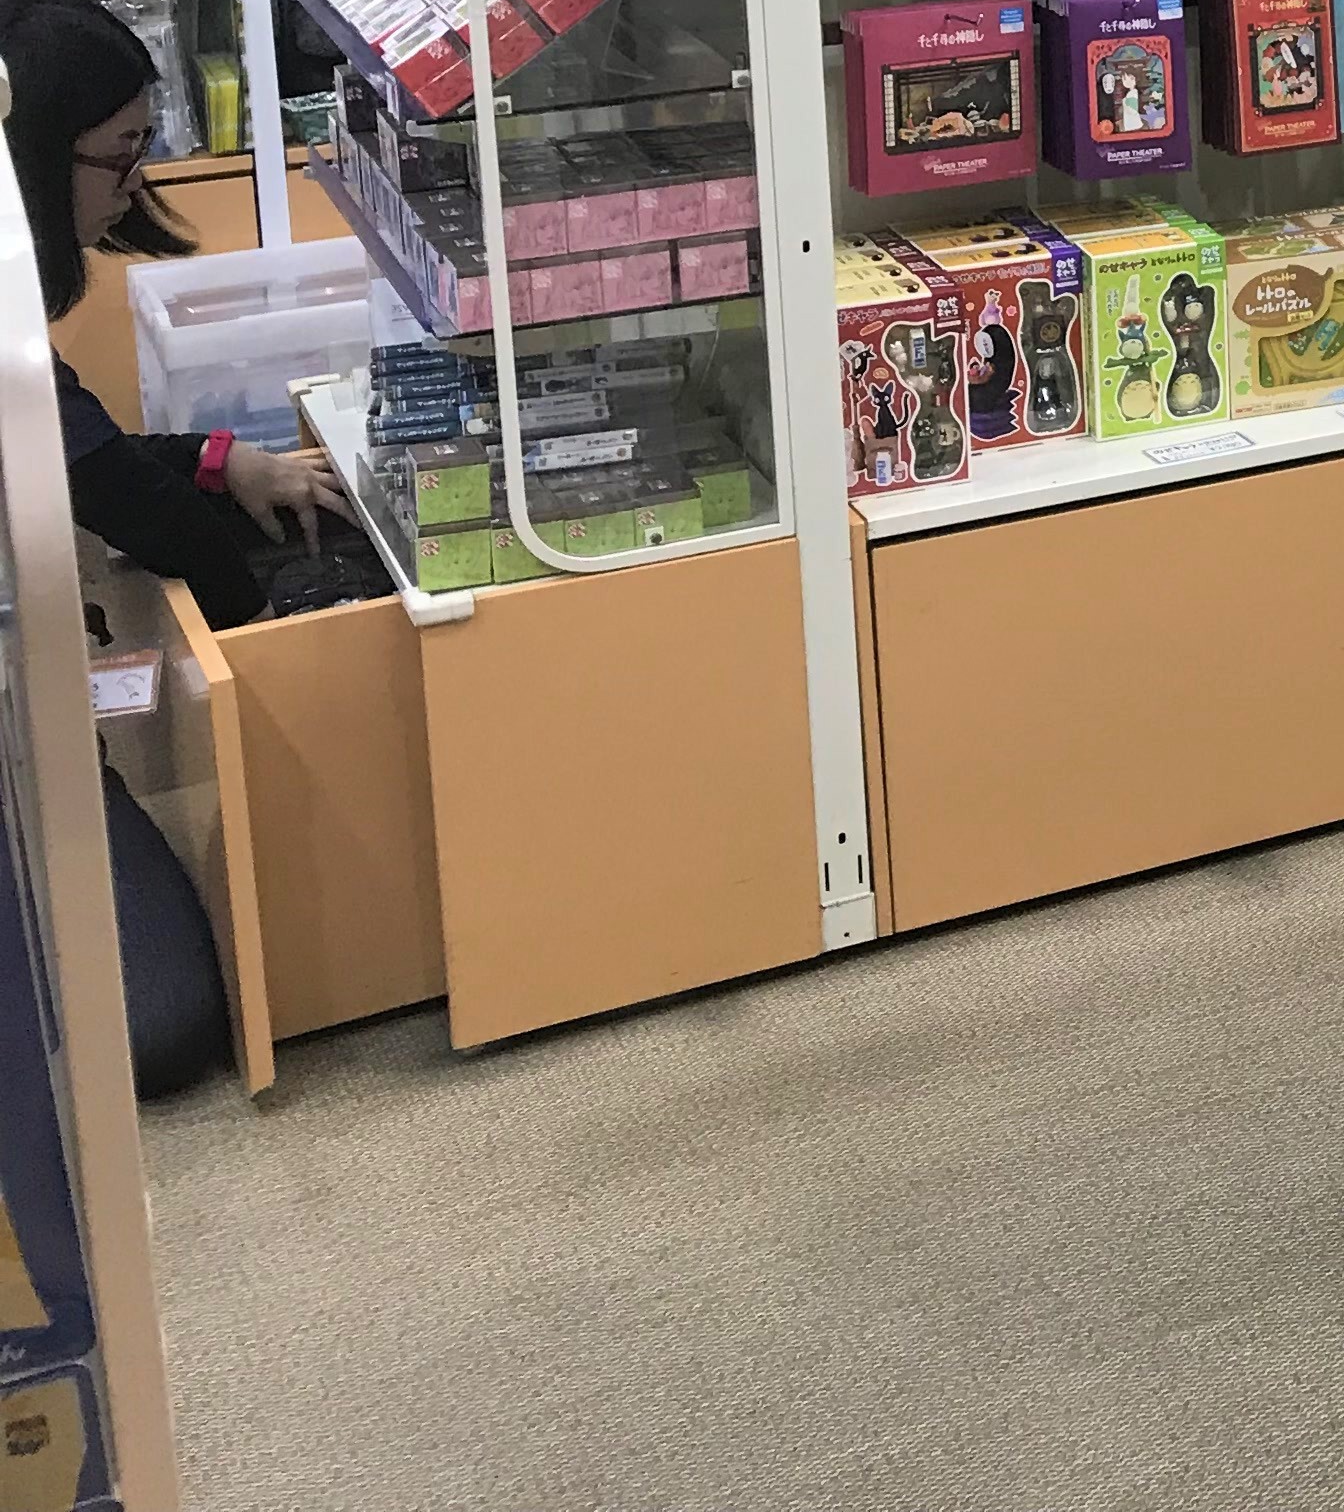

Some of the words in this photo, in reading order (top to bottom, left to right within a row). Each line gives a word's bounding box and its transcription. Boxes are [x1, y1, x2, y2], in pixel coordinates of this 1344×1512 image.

[1107, 150, 1130, 160] PAPER
[1131, 146, 1163, 157] THEATER
[933, 161, 955, 172] PAPER
[956, 157, 988, 169] THEATER
[1257, 285, 1297, 300] トトロの
[1245, 297, 1312, 316] レールパズル
